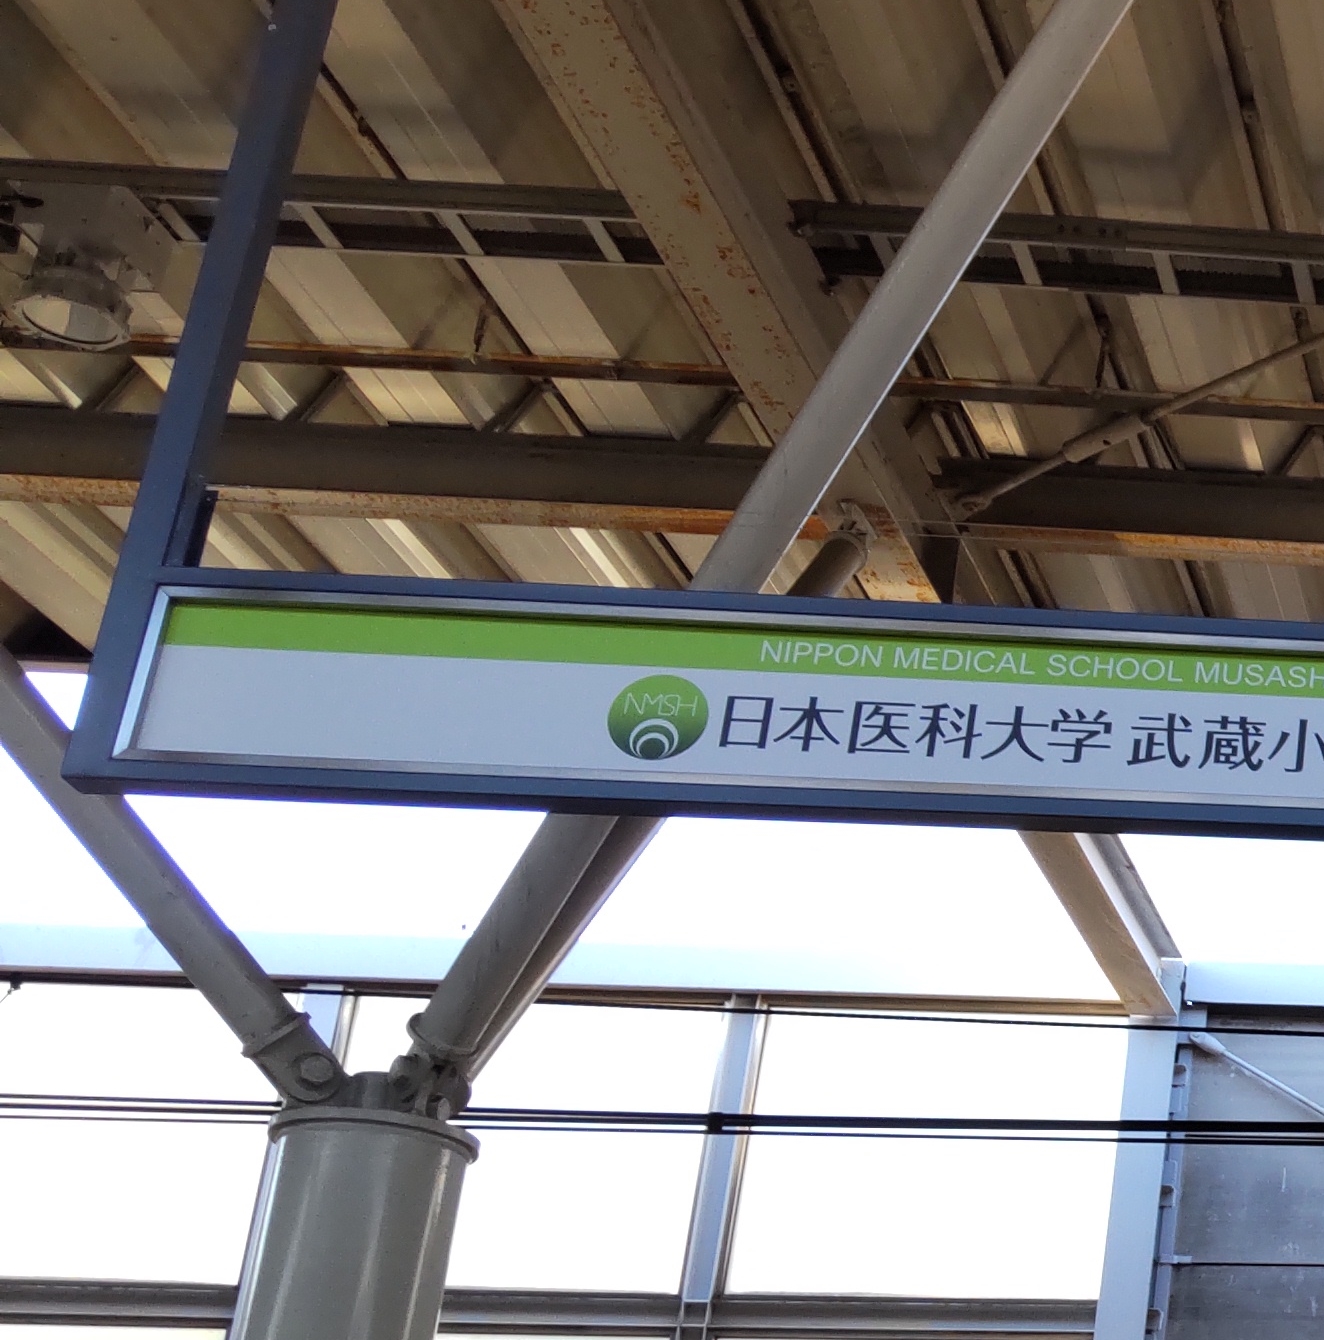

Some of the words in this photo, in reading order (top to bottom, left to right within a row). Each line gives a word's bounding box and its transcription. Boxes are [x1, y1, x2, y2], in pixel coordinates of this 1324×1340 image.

[759, 639, 884, 670] NIPPON
[892, 647, 1036, 676] MEDICAL
[1045, 654, 1184, 684] SCHOOL
[718, 695, 1112, 765] 日本医科大学
